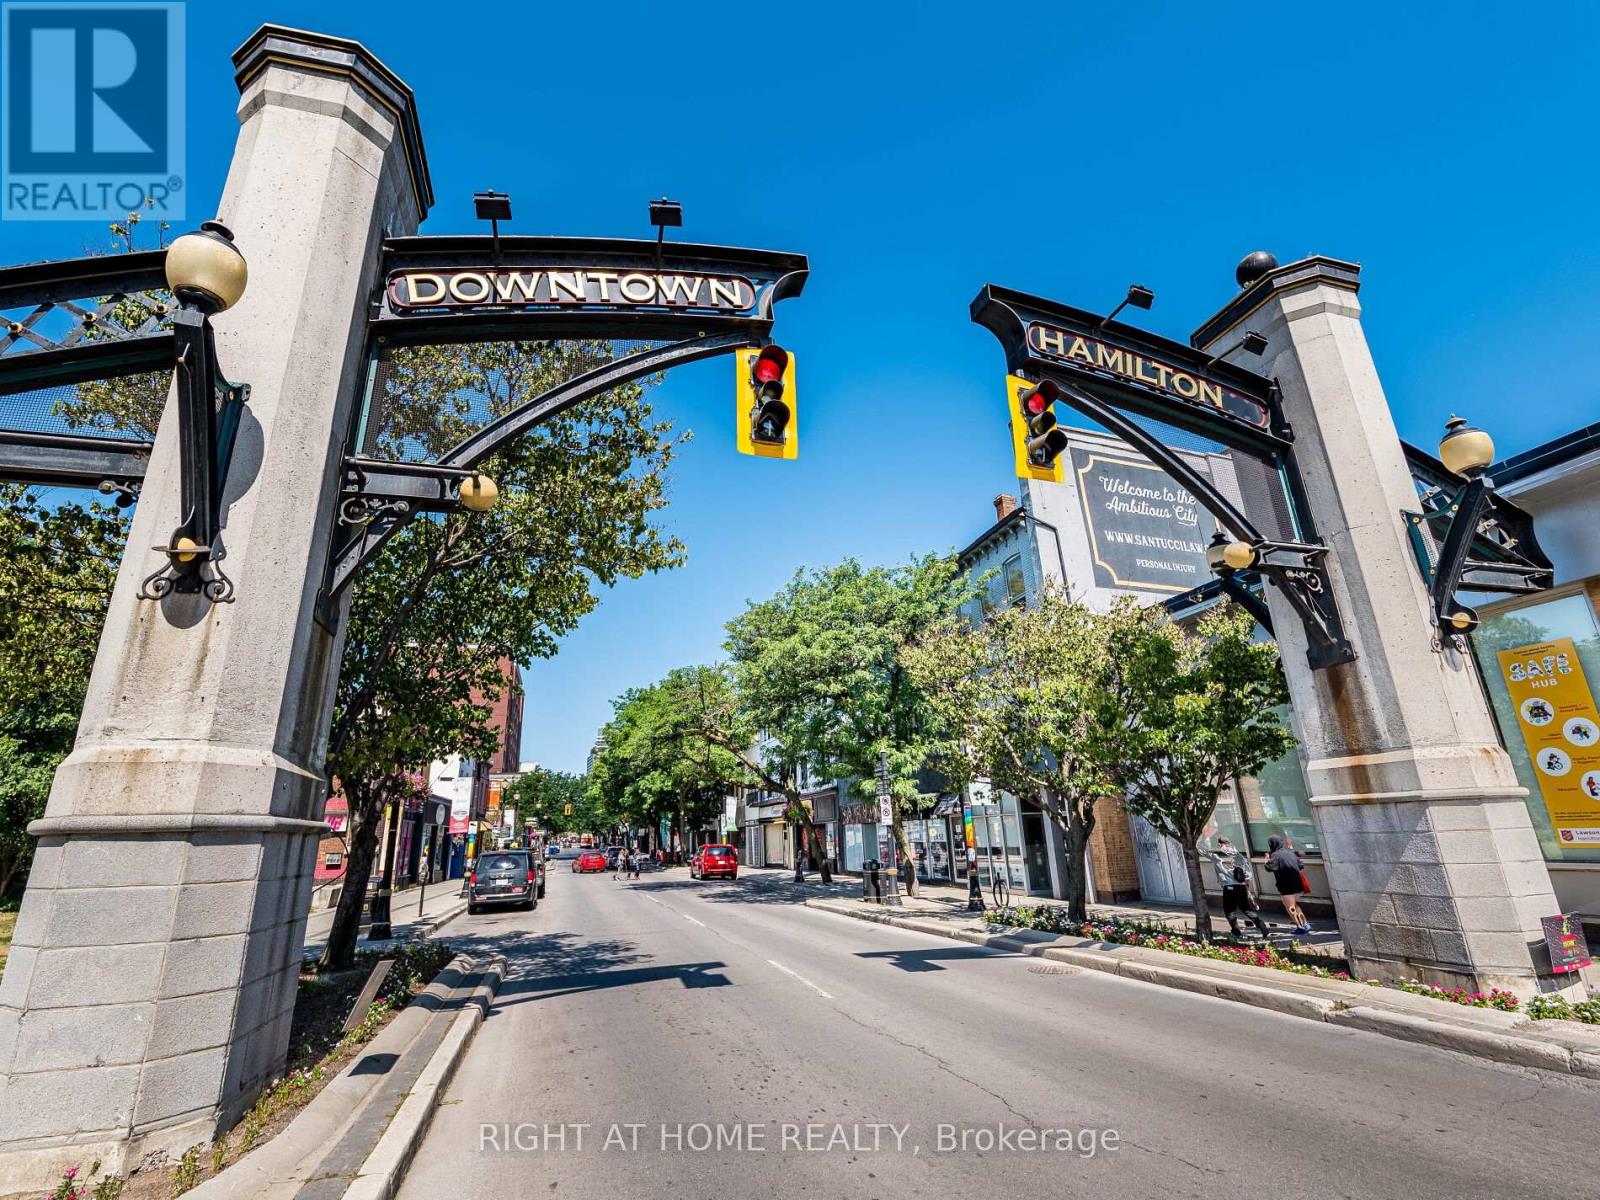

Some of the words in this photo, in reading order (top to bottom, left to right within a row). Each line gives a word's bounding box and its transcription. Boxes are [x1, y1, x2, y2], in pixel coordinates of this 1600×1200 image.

[406, 271, 744, 308] DOWNTOWN
[1038, 326, 1223, 409] HAMILTON
[1098, 475, 1162, 501] Welcome
[1162, 487, 1176, 503] to
[1176, 489, 1197, 505] the
[1105, 495, 1172, 519] Ambitious
[1172, 504, 1199, 527] City
[1136, 558, 1173, 571] PERSONAL
[1509, 652, 1573, 682] SAFE
[1531, 678, 1558, 689] HUB
